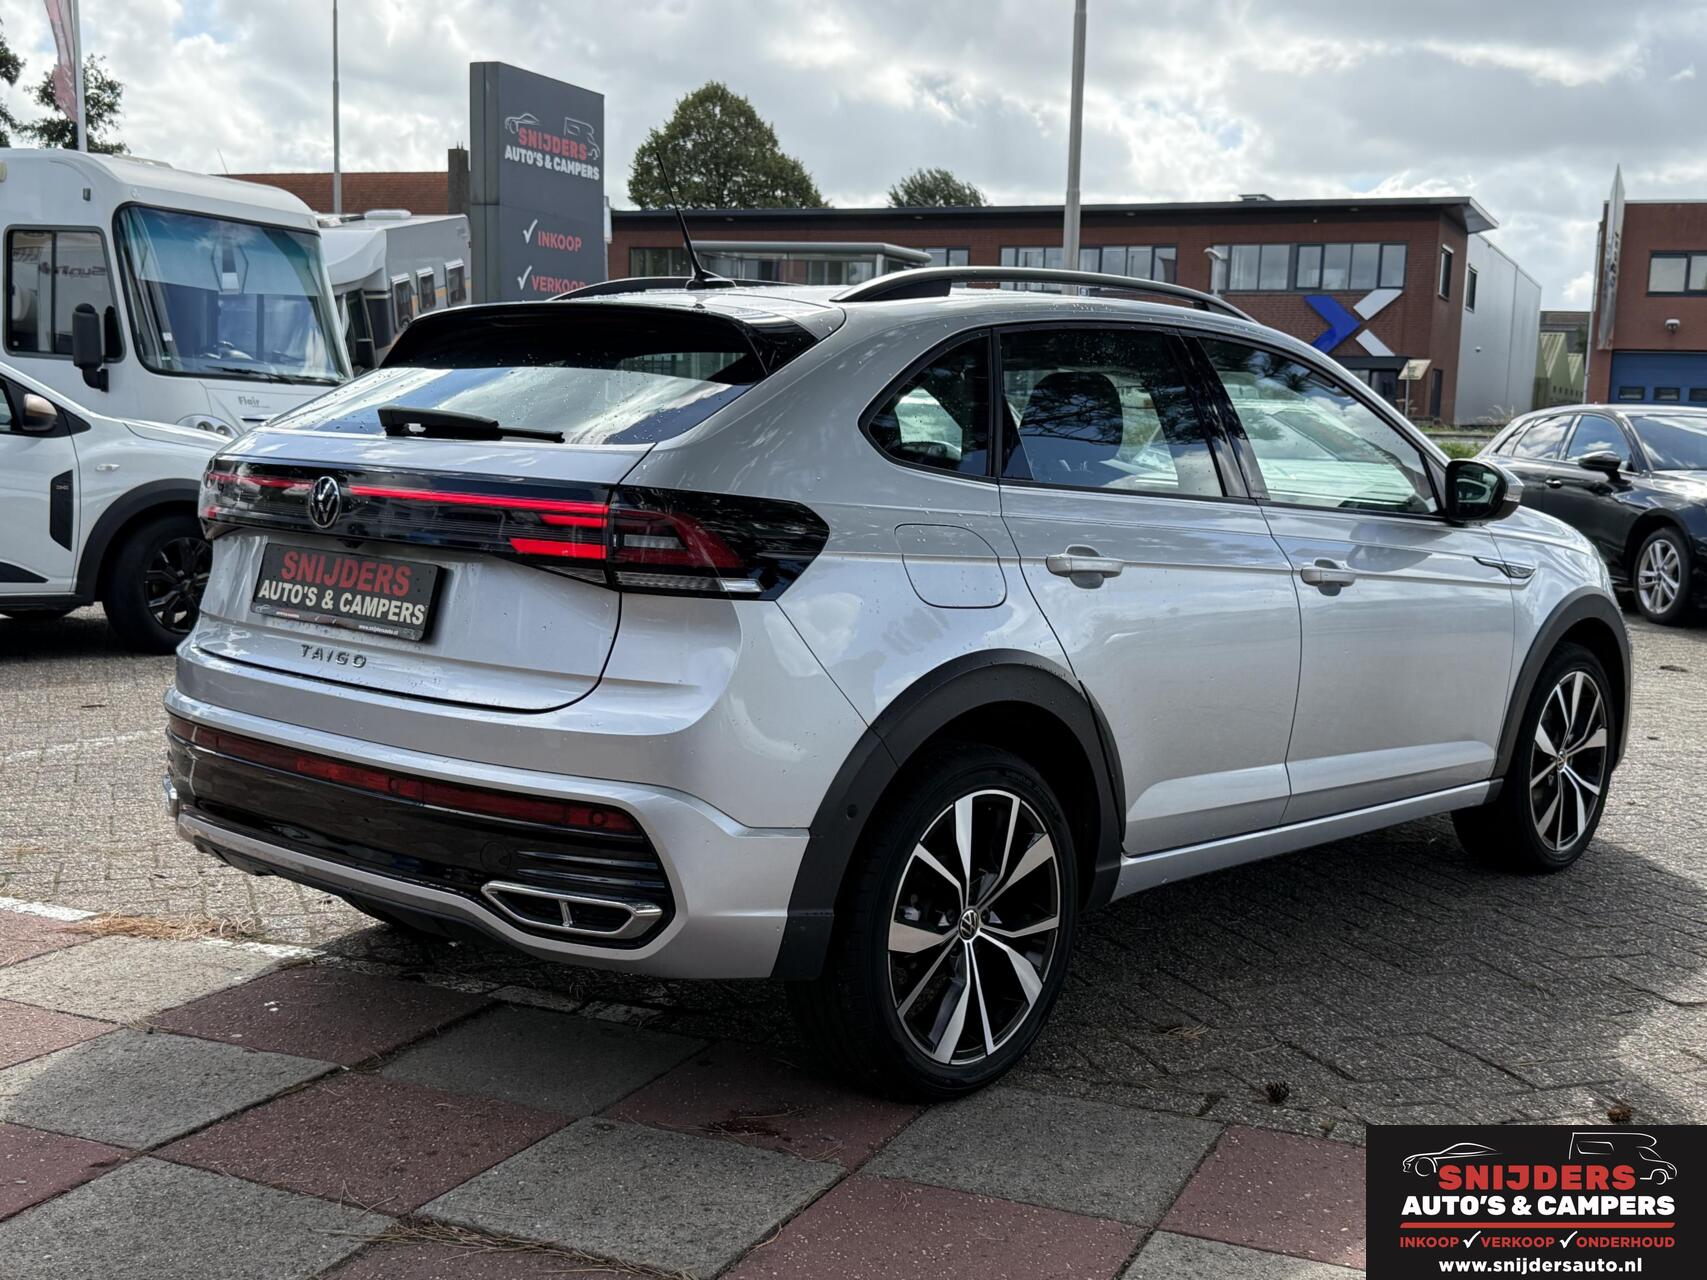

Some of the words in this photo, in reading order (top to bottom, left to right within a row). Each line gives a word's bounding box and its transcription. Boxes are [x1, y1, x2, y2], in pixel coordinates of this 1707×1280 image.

[518, 127, 588, 161] SNIJDERS
[504, 145, 544, 168] AUTO'S
[544, 156, 553, 170] &
[553, 157, 600, 181] CAMPERS
[538, 230, 582, 252] INKOOP
[281, 550, 413, 598] SNIJDERS
[258, 579, 318, 607] AUTO'S
[321, 589, 334, 610] &
[339, 592, 426, 625] CAMPERS
[300, 644, 367, 669] TAIGO
